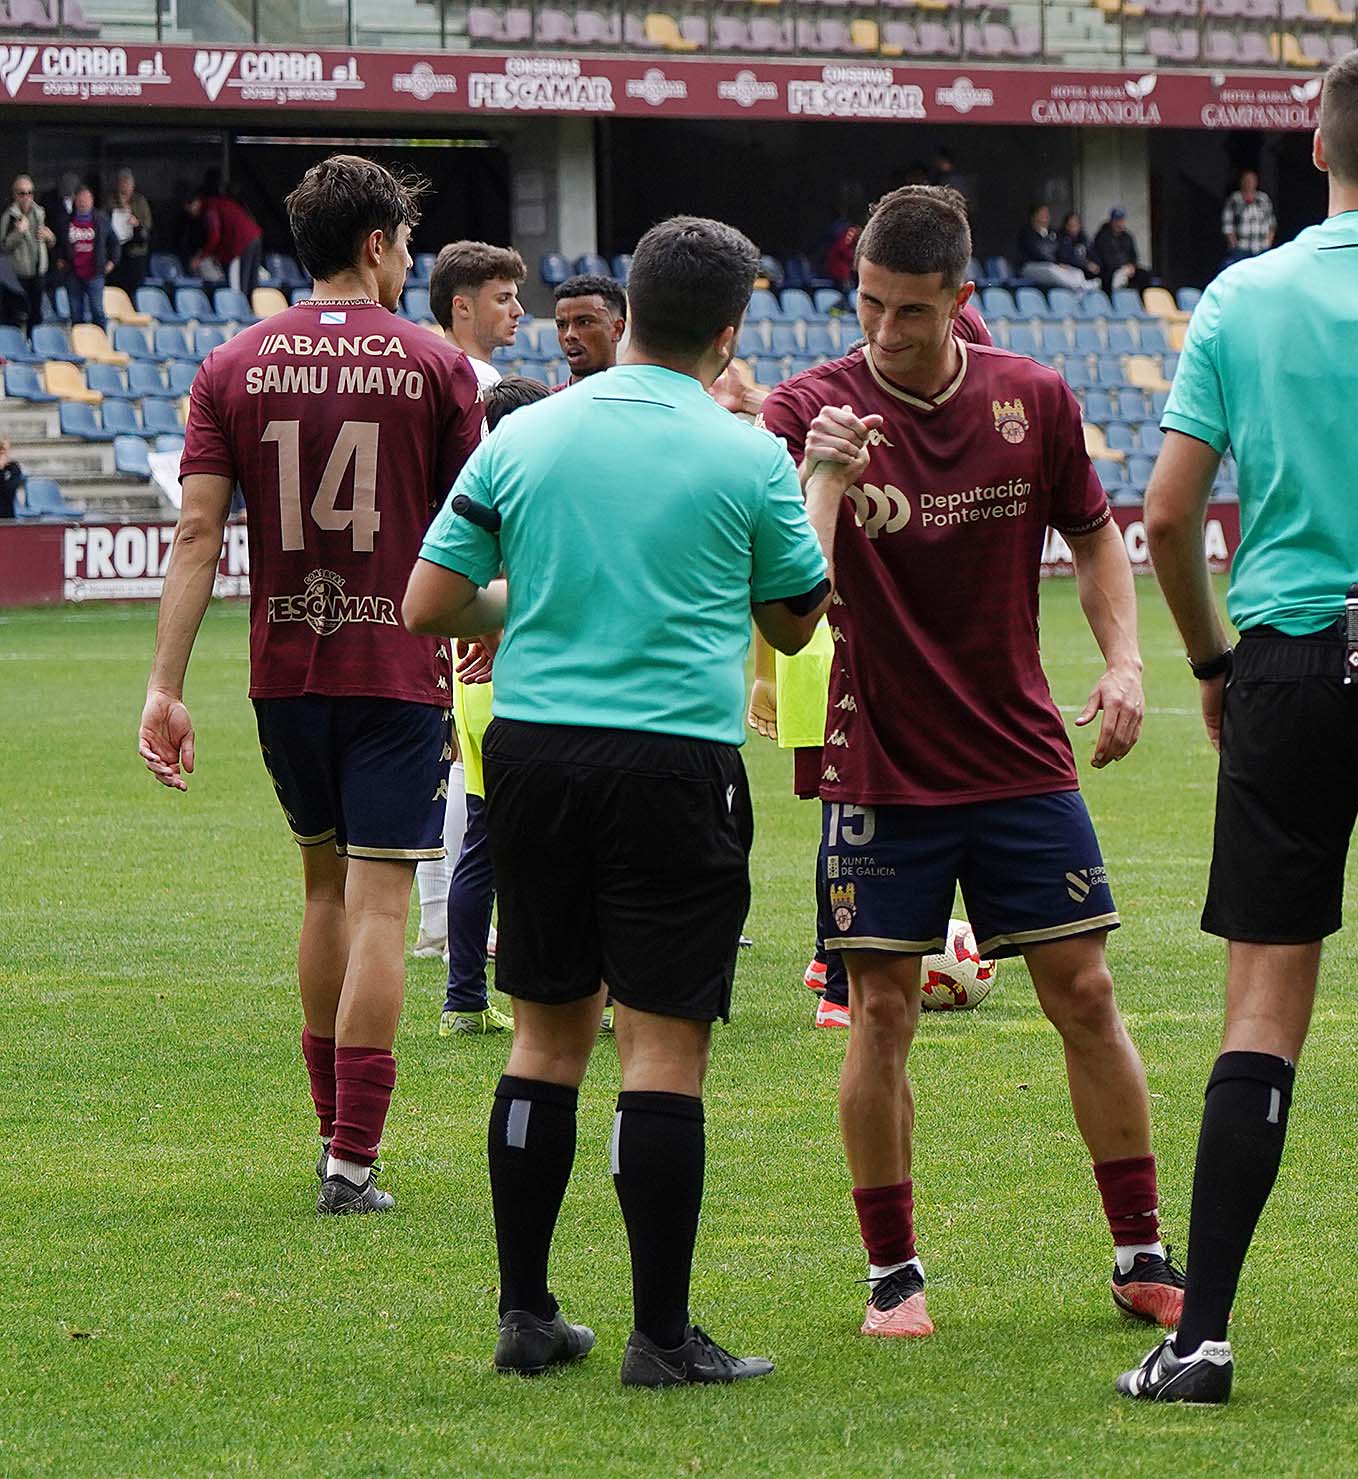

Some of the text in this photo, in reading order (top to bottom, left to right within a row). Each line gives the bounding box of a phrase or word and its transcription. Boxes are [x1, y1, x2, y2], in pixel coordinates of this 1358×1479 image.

[42, 46, 127, 76] CORBA
[240, 52, 323, 82] CORBA
[505, 58, 581, 77] CONSERVAS
[468, 73, 616, 111] PESCAMAR
[788, 80, 927, 118] PESCAMAR
[246, 365, 424, 400] SAMU MAYO
[260, 419, 381, 553] 14
[920, 478, 1031, 511] Deputación
[63, 526, 176, 579] FROIZ
[828, 803, 876, 847] 15
[841, 857, 876, 866] XUNTA
[841, 866, 896, 876] DE GALICIA
[1201, 1347, 1231, 1357] adida
